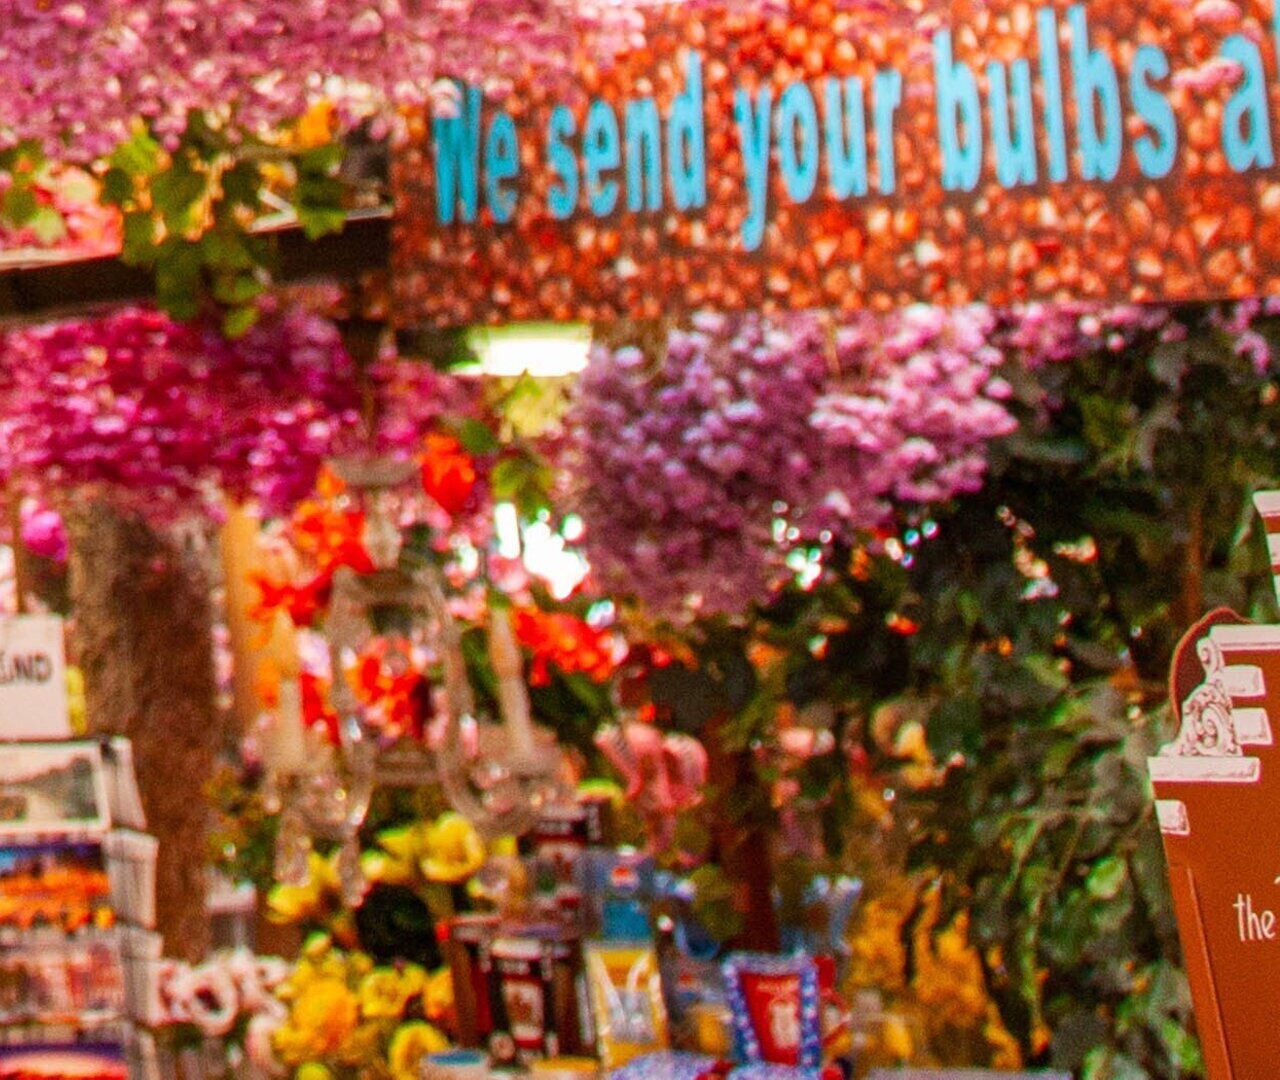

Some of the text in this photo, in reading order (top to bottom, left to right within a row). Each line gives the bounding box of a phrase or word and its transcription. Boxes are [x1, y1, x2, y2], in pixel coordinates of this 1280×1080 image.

[431, 78, 520, 225] We
[546, 50, 707, 220] send
[733, 69, 904, 252] your
[933, 3, 1178, 192] bulbs
[1232, 893, 1276, 942] the
